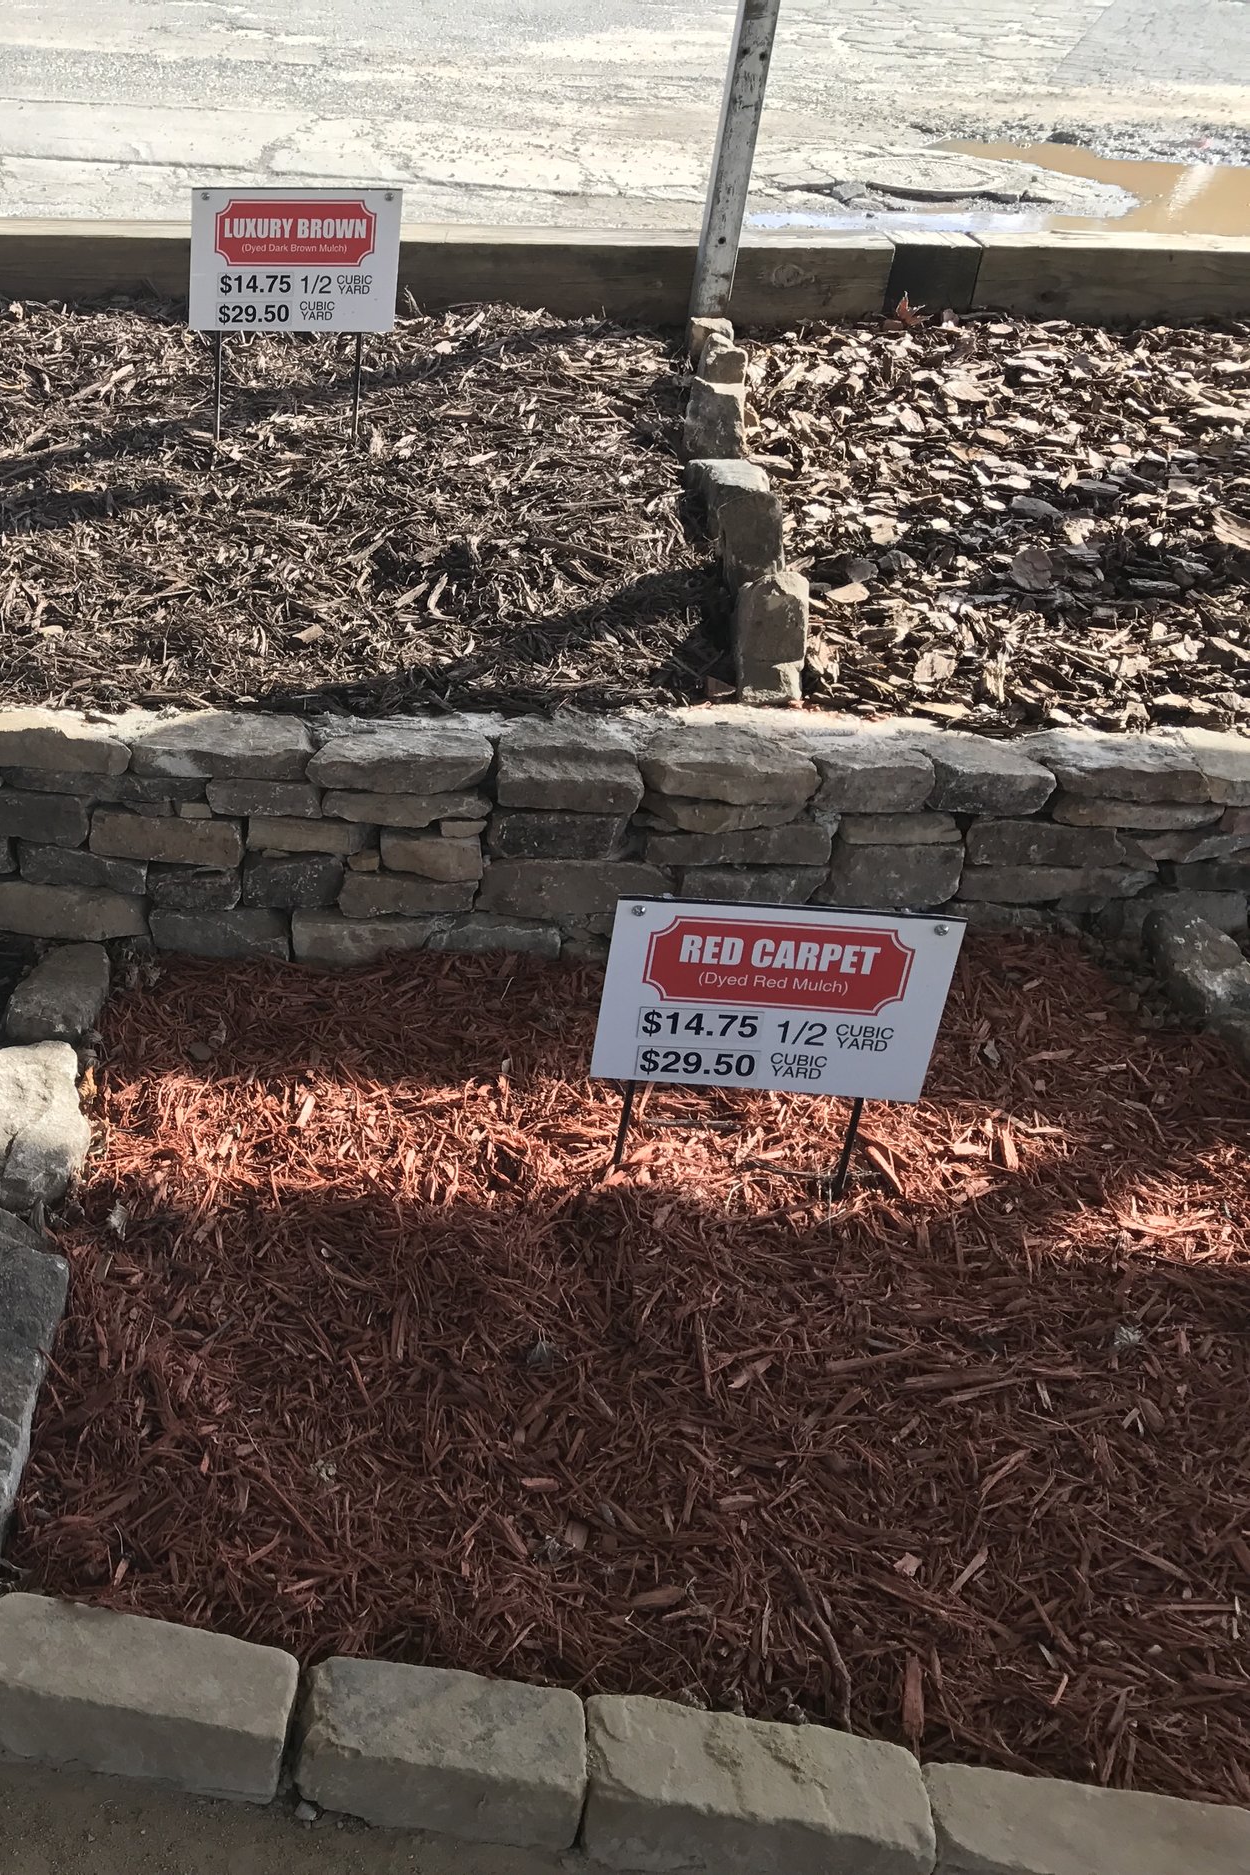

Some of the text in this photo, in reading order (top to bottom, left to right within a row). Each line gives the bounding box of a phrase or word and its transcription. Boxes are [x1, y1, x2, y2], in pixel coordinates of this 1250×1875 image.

[224, 218, 367, 239] LUXURY BROWN
[242, 244, 347, 253] (Dyed Dark Brown Mulch)
[220, 274, 332, 295] $14.75 1/2
[337, 275, 372, 284] CUBIC
[338, 285, 370, 294] YARD
[300, 301, 335, 310] CUBIC
[219, 304, 289, 325] $29.50
[301, 311, 333, 320] YARD
[679, 934, 881, 975] RED CARPET
[698, 972, 849, 996] (Dyed Red Mulch)
[641, 1010, 828, 1047] $14.75 1/2
[835, 1024, 894, 1039] CUBIC
[837, 1037, 888, 1052] YARD
[639, 1048, 755, 1077] $29.50
[770, 1053, 828, 1068] CUBIC
[771, 1065, 822, 1080] YARD
